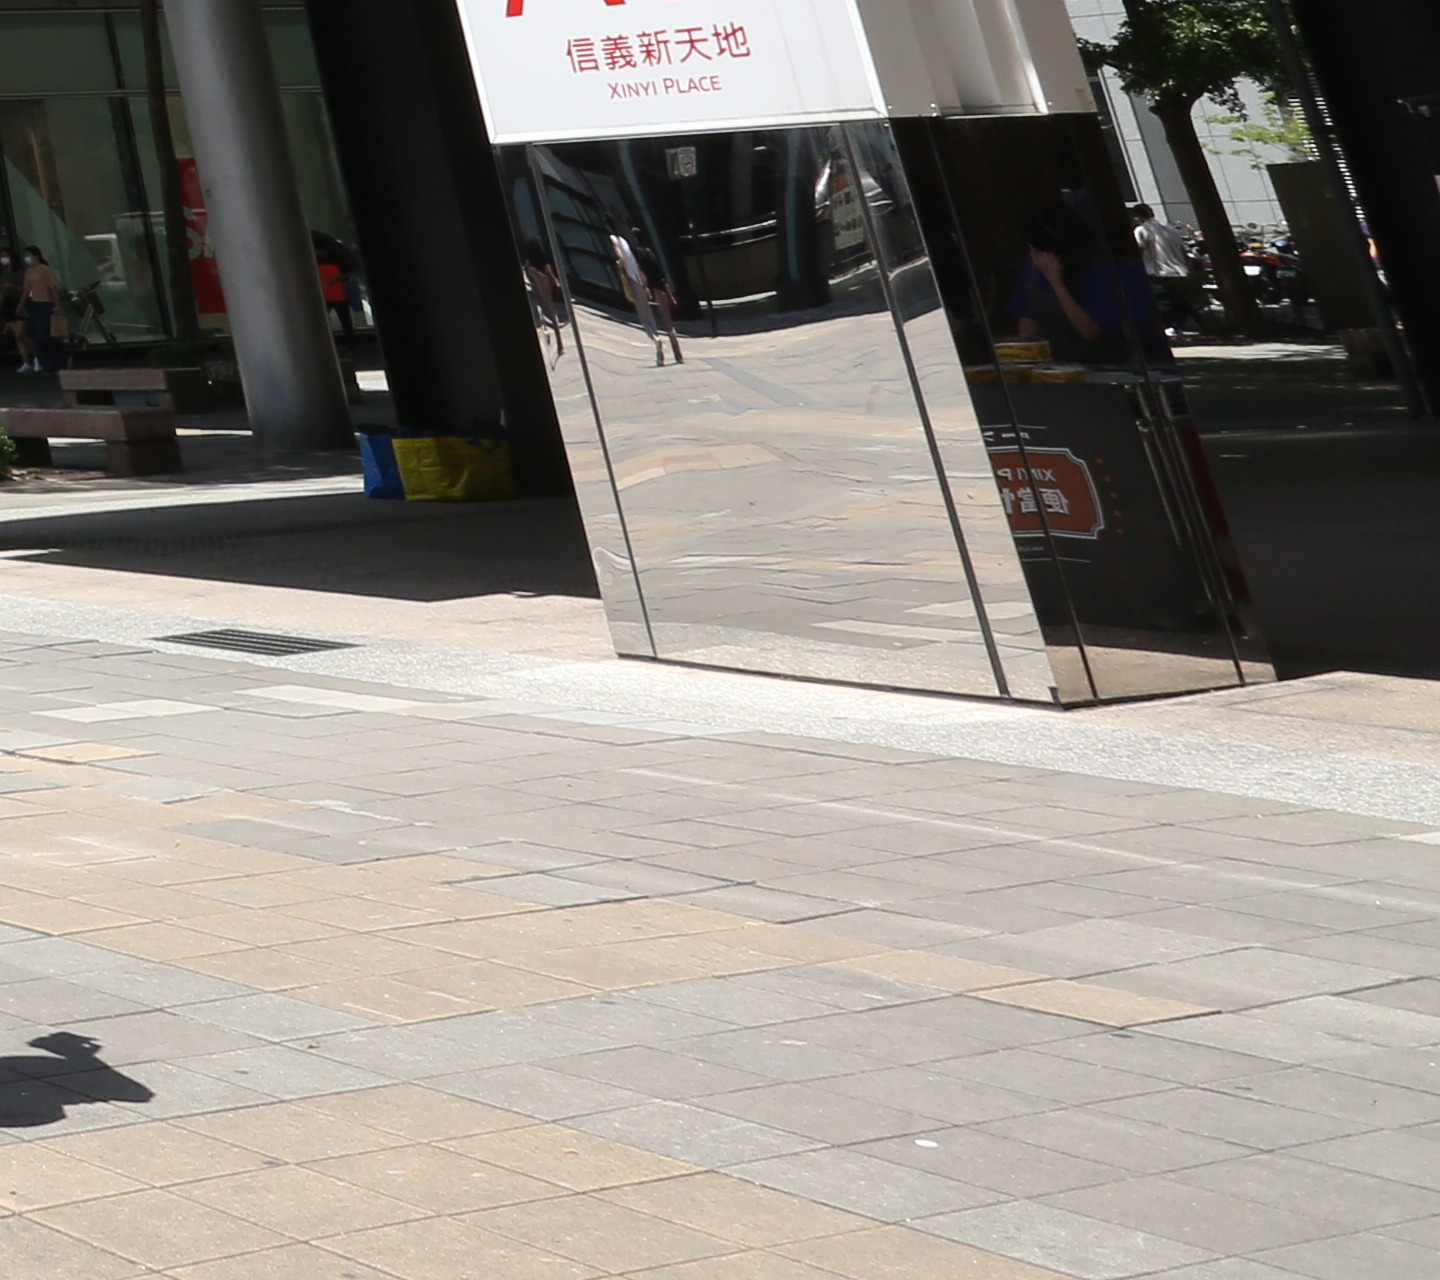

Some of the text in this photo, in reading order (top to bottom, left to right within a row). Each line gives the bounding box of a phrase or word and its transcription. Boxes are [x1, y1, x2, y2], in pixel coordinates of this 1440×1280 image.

[564, 20, 752, 75] 信義新天地
[607, 74, 723, 100] XINYI PLACE
